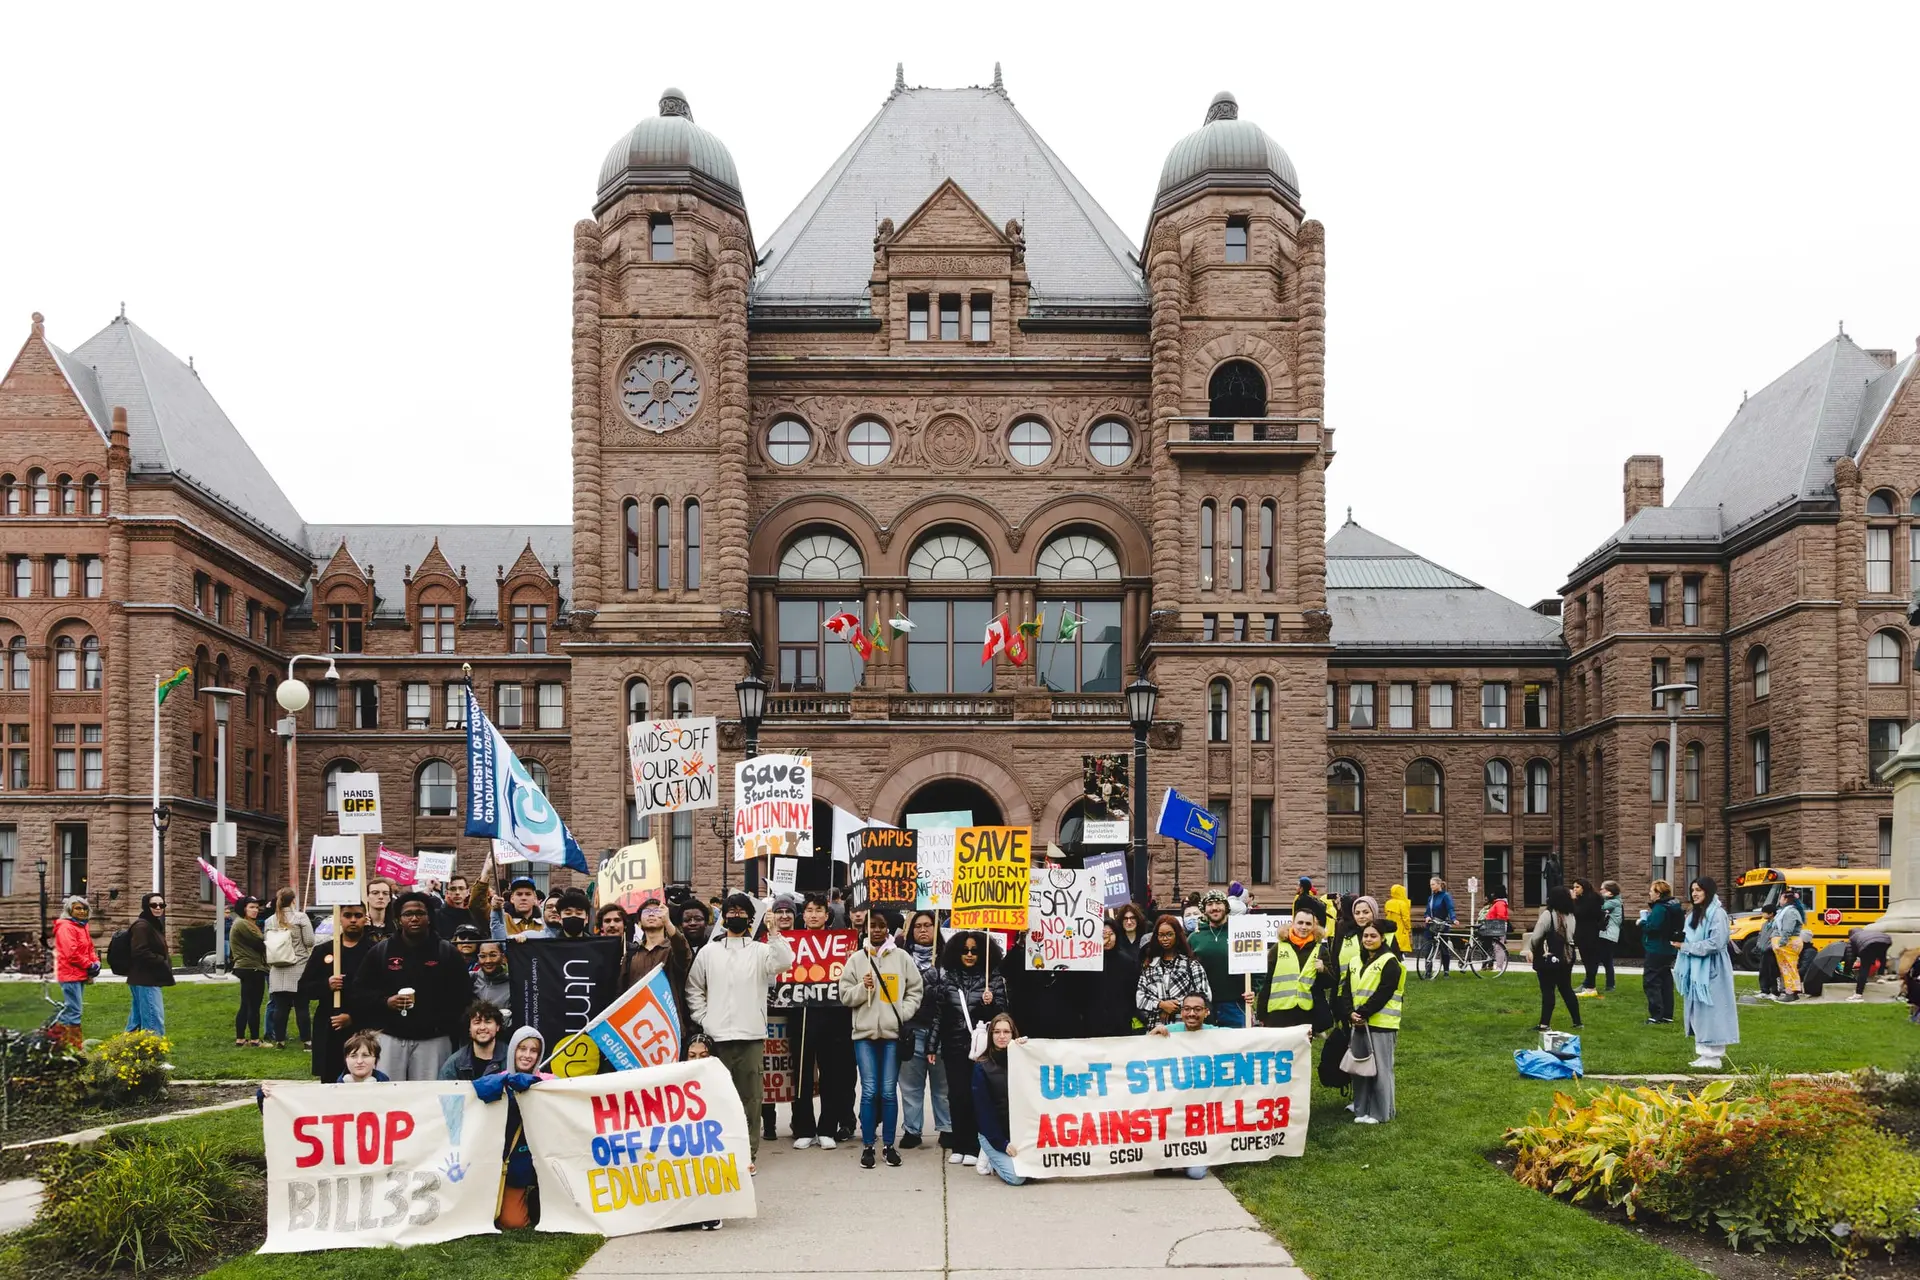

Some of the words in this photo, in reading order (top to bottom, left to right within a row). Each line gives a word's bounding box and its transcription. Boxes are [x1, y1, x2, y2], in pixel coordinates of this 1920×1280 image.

[473, 734, 482, 750] OF
[679, 727, 710, 750] OFF
[643, 758, 679, 780] OUR
[741, 763, 805, 792] Save
[343, 790, 374, 798] HANDS
[473, 751, 483, 821] UNIVERSITY
[484, 769, 494, 824] GRADUATE
[344, 799, 374, 812] OFF
[862, 830, 913, 848] CAMPUS
[959, 830, 1028, 864] SAVE
[322, 856, 354, 864] HANDS
[865, 859, 918, 879] RIGHTS
[322, 865, 355, 880] OFF
[611, 859, 646, 893] NO
[958, 865, 1028, 880] STUDENT
[620, 884, 634, 892] TO
[954, 880, 1027, 904] AUTONOMY
[1041, 889, 1082, 918] SAY
[953, 911, 981, 926] STOP
[983, 909, 1009, 925] BILL
[1011, 910, 1026, 926] 33
[1040, 917, 1065, 936] NO
[1074, 917, 1095, 938] TO
[1234, 931, 1262, 939] HANDS
[1234, 939, 1262, 953] OFF
[1044, 939, 1078, 960] BILL
[777, 983, 838, 1003] CENTE
[633, 1019, 671, 1065] cfs
[1125, 1050, 1294, 1094] STUDENTS
[591, 1080, 707, 1134] HANDS
[1036, 1107, 1172, 1148] AGAINST
[293, 1110, 415, 1168] STOP
[591, 1131, 643, 1166] OFF
[667, 1120, 725, 1157] OUR
[1043, 1151, 1091, 1168] UTMSU
[1110, 1148, 1144, 1165] SCSU
[1164, 1141, 1208, 1158] UTGSU
[587, 1153, 741, 1213] EDUCATION
